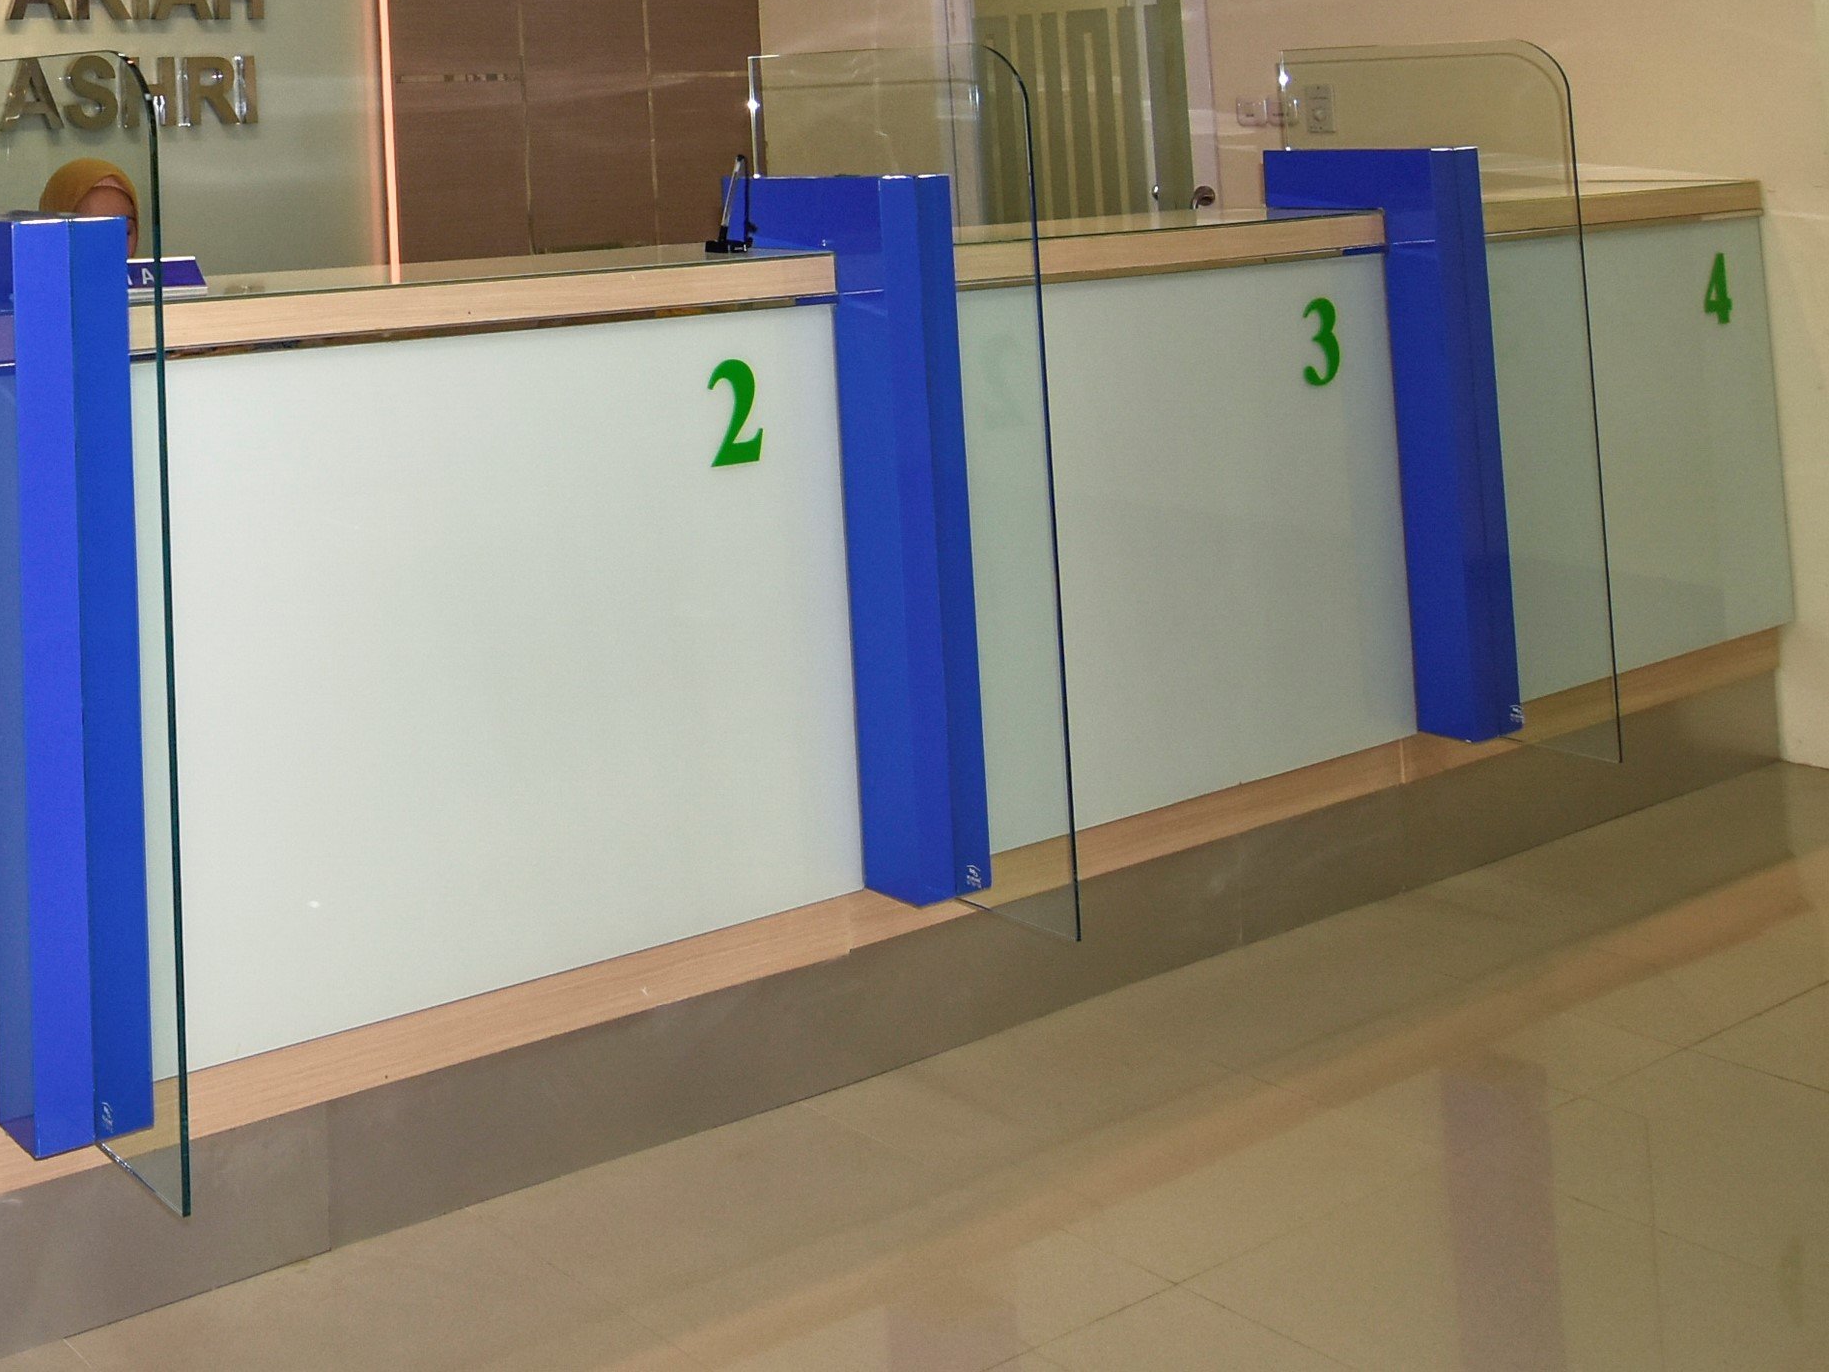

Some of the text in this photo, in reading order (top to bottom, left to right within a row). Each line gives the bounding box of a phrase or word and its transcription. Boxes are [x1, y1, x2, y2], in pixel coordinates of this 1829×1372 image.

[1704, 253, 1732, 324] 4
[1302, 297, 1340, 386] 3
[707, 358, 763, 467] 2
